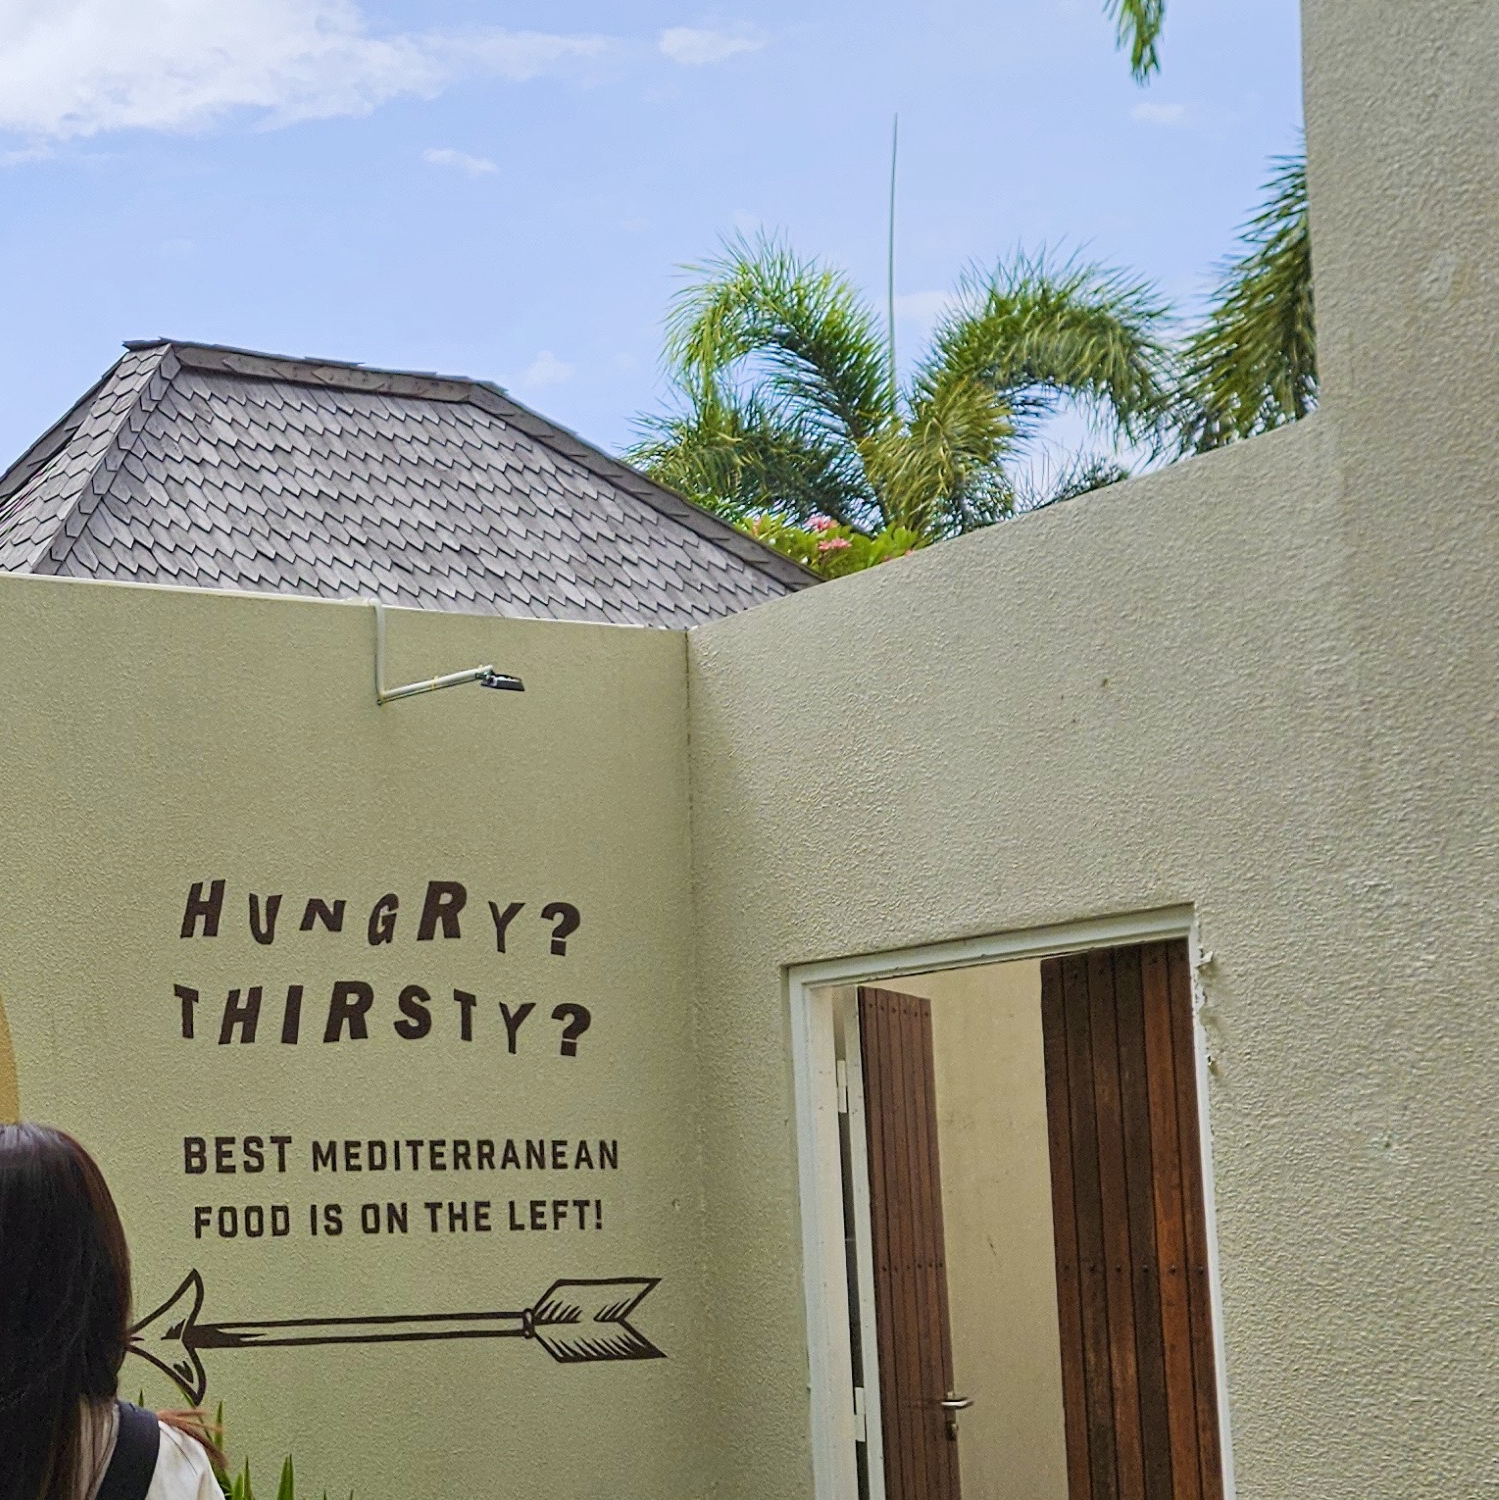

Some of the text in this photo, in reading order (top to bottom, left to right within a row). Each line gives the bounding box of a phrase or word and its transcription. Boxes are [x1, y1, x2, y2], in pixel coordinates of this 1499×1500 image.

[179, 878, 582, 957] HUNGRY?
[173, 980, 592, 1057] THIRSTY?
[183, 1135, 619, 1175] BEST MEDITERRANEAN
[194, 1199, 603, 1239] FOOD IS ON THE LEFT!
